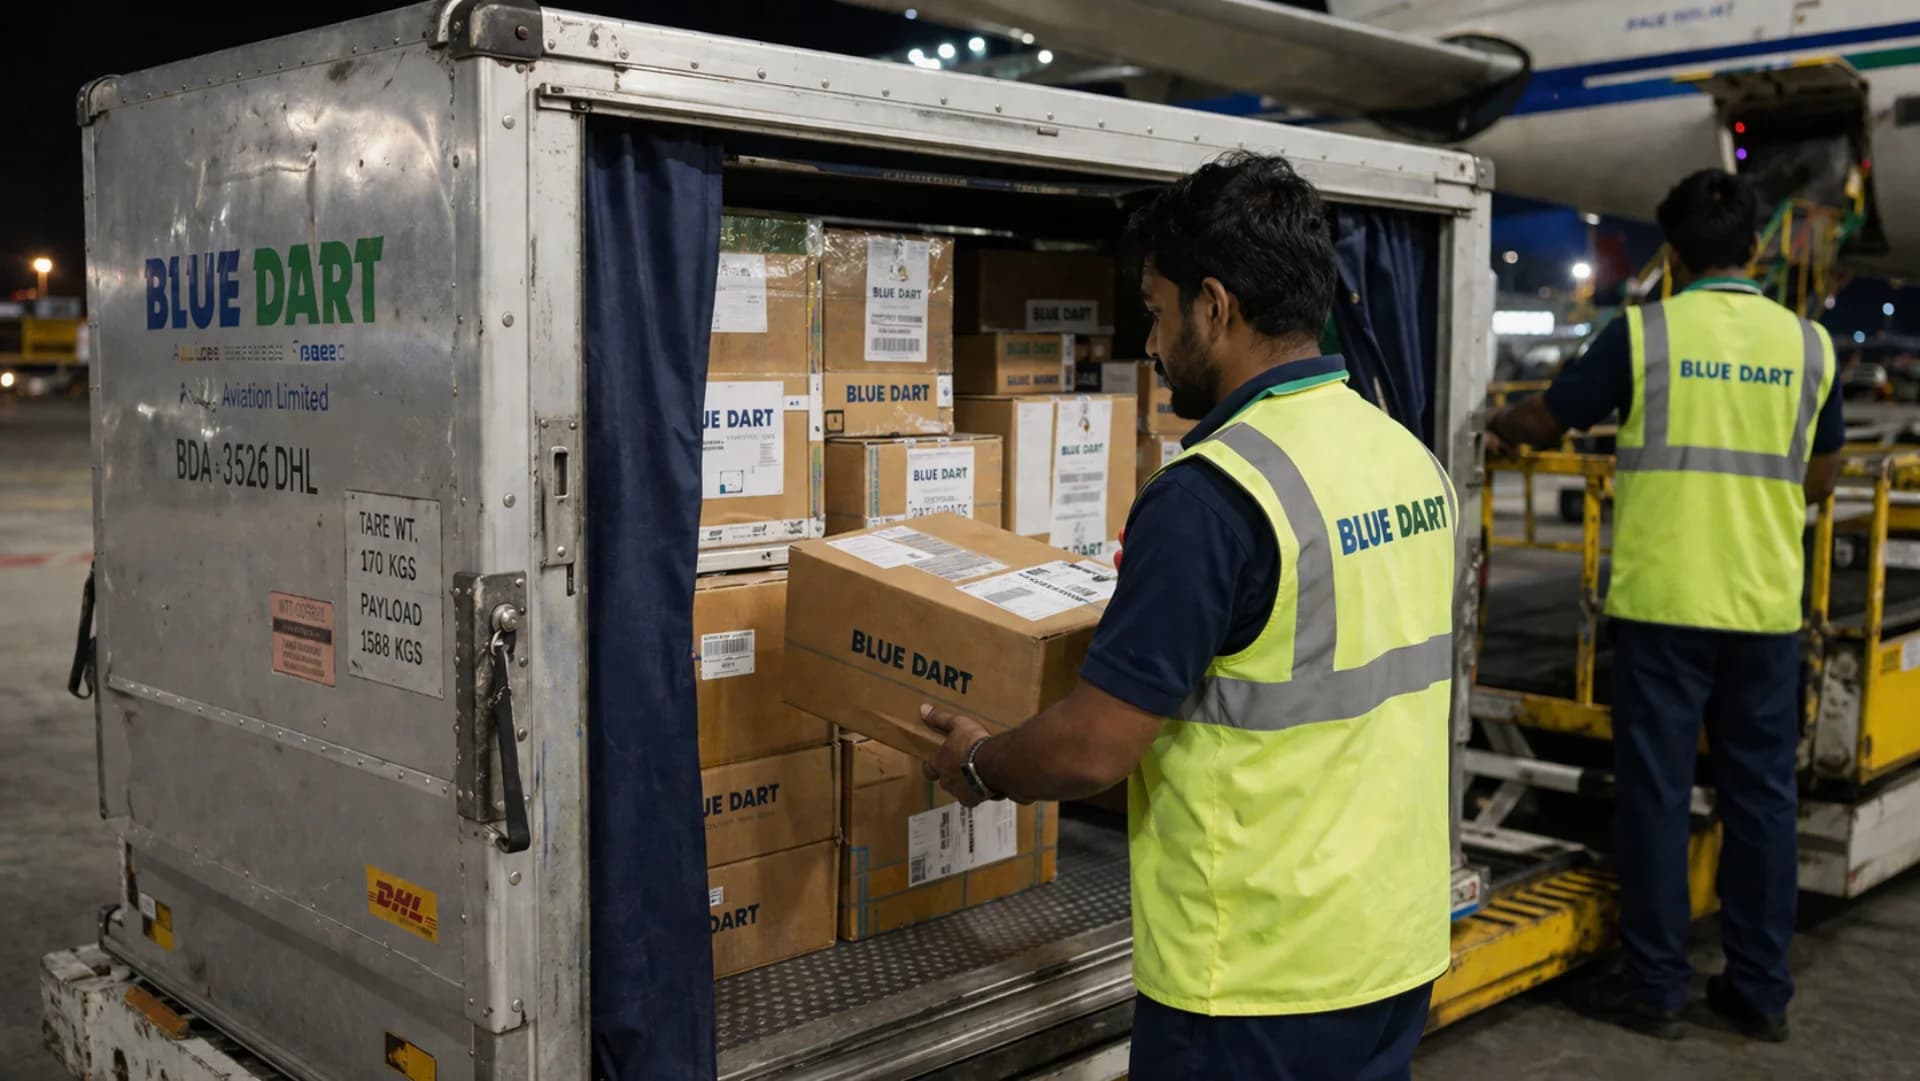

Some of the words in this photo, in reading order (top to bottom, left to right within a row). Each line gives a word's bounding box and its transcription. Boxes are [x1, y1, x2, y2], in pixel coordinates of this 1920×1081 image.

[145, 249, 240, 330] BLUE
[253, 235, 384, 326] DART
[872, 287, 895, 299] BLUE
[898, 287, 922, 300] DART
[1680, 360, 1732, 380] BLUE
[1739, 364, 1793, 387] DART
[222, 383, 272, 410] Aviation
[276, 383, 329, 412] Limited
[846, 384, 885, 403] BLUE
[890, 384, 930, 401] DART
[727, 408, 774, 429] DART
[176, 438, 212, 483] BDA
[223, 441, 269, 489] 3526
[275, 445, 318, 494] DHL
[913, 468, 938, 481] BLUE
[942, 467, 967, 480] DART
[359, 511, 390, 538] TARE
[394, 517, 418, 543] WT.
[1336, 507, 1394, 556] BLUE
[1395, 495, 1447, 538] DART
[360, 550, 384, 575] 170
[389, 554, 416, 581] KGS
[361, 592, 423, 626] PAYLOAD
[361, 629, 390, 657] 1588
[395, 637, 423, 665] KGS
[852, 628, 906, 670] BLUE
[911, 652, 974, 695] DART
[729, 783, 780, 812] DART
[375, 879, 423, 924] DHL
